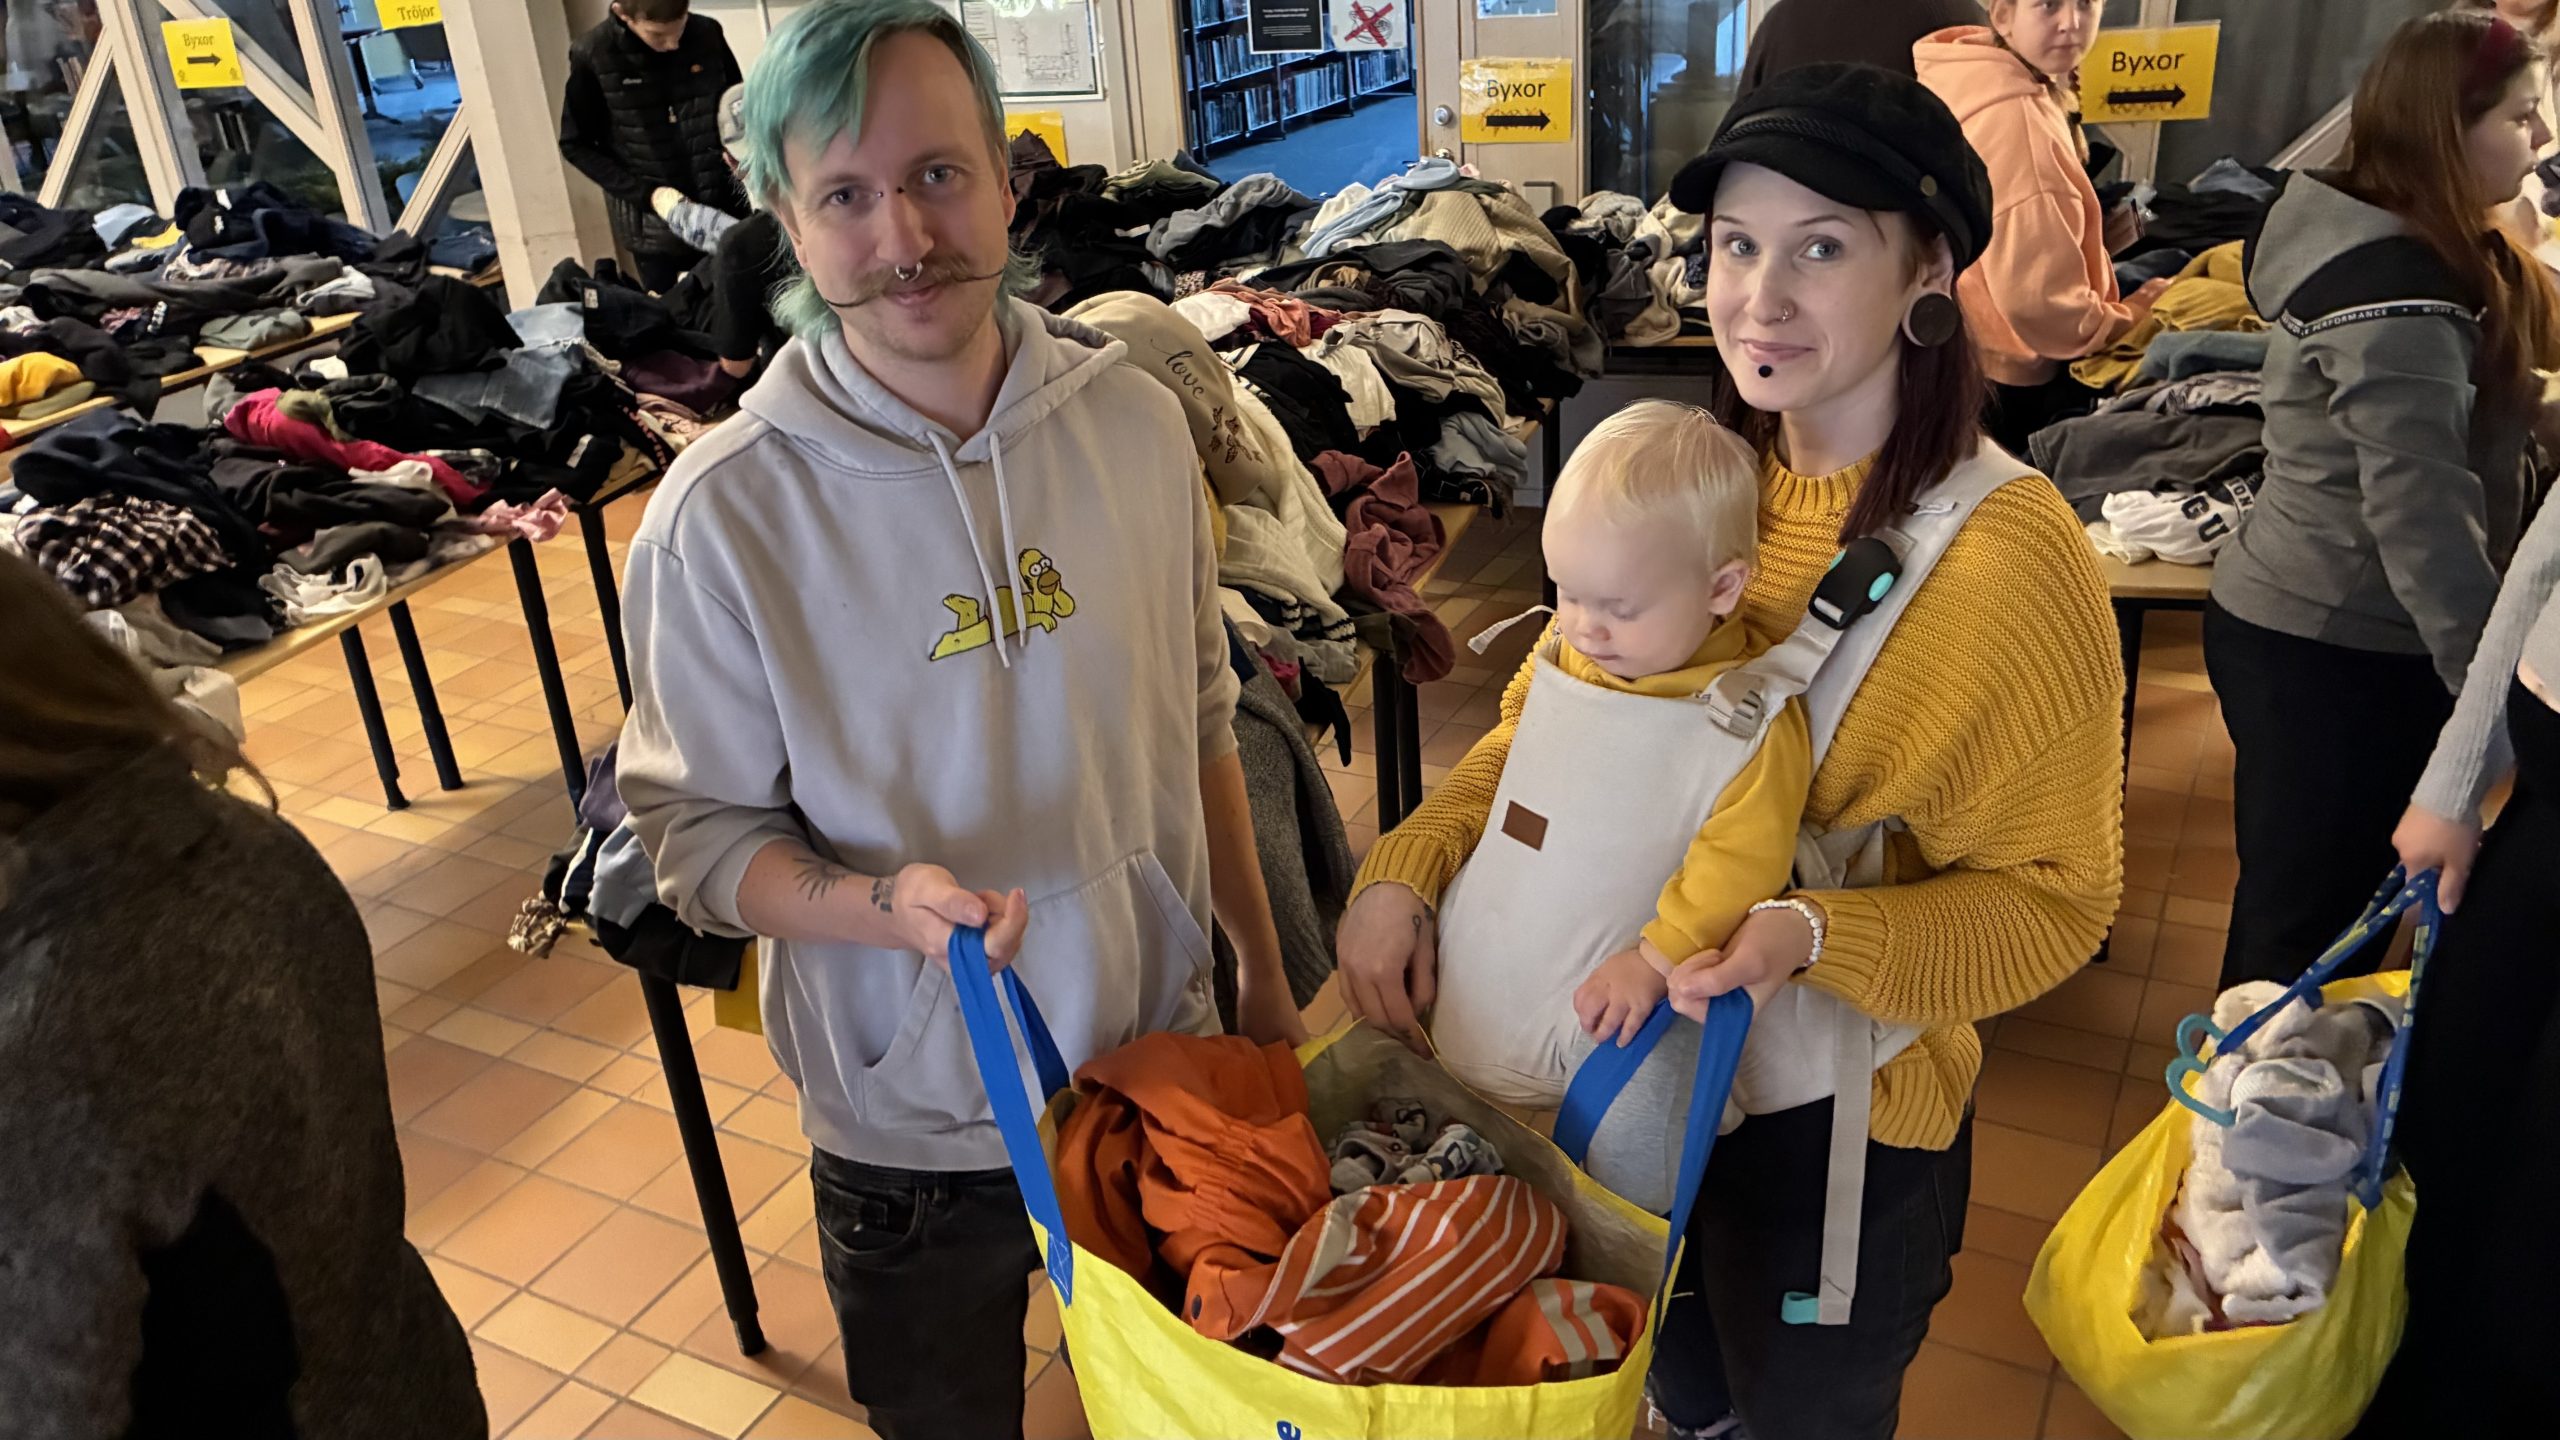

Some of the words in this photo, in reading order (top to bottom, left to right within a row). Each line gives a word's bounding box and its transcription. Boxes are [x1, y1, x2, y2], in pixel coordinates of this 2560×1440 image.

[397, 5, 435, 21] Tröjor
[182, 33, 215, 50] Byxor
[2111, 51, 2186, 77] Byxor
[1486, 79, 1547, 103] Byxor
[2312, 308, 2388, 332] PERFORMANCE
[1151, 338, 1204, 400] love
